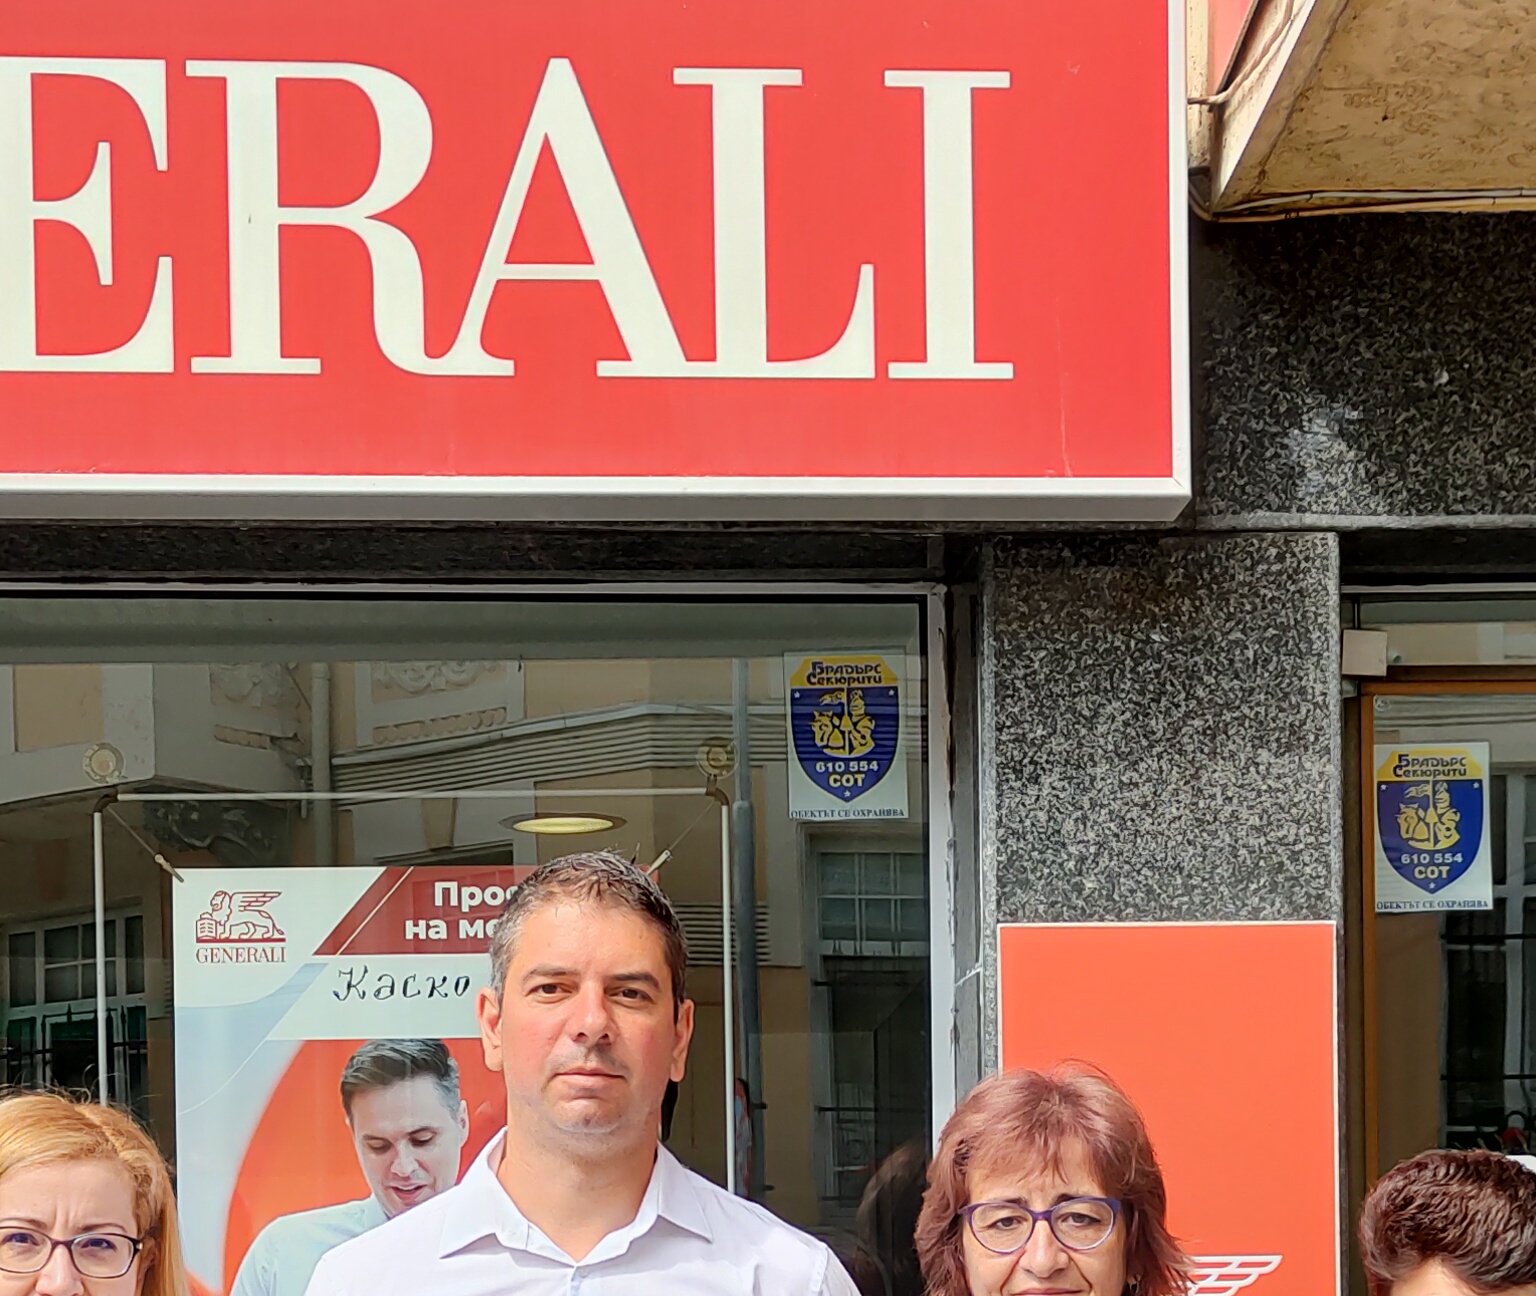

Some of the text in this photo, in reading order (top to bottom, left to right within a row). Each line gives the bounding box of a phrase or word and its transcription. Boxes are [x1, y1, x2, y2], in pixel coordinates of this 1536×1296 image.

[816, 761, 878, 772] 610 554
[829, 773, 865, 787] СОТ
[1401, 853, 1463, 864] 610 554
[1414, 866, 1450, 879] СОТ
[405, 919, 448, 940] на
[195, 947, 286, 964] GENERALI
[332, 965, 470, 1002] Каско
